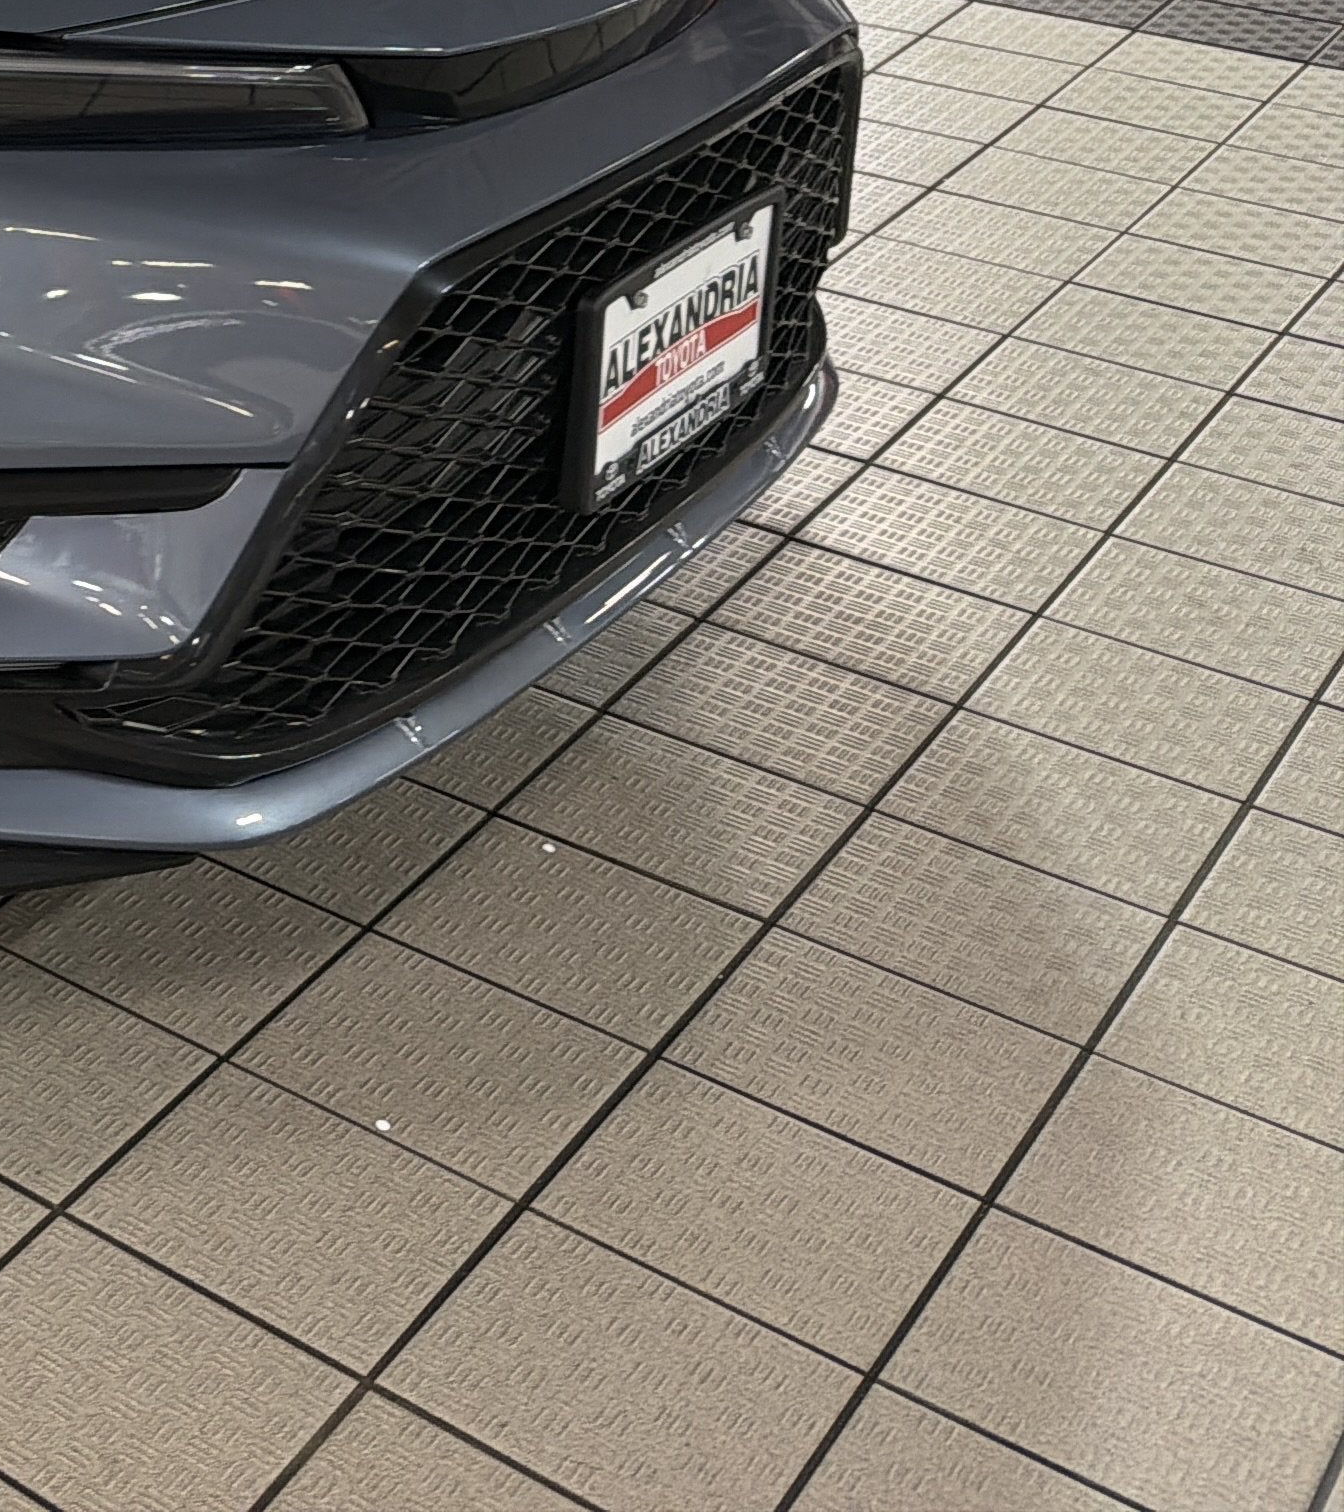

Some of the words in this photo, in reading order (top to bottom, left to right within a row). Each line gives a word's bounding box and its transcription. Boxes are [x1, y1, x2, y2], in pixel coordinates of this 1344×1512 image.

[602, 254, 758, 399] ALEXANDRIA
[655, 329, 707, 387] TOYOTA
[635, 382, 731, 476] ALEXANDRIA
